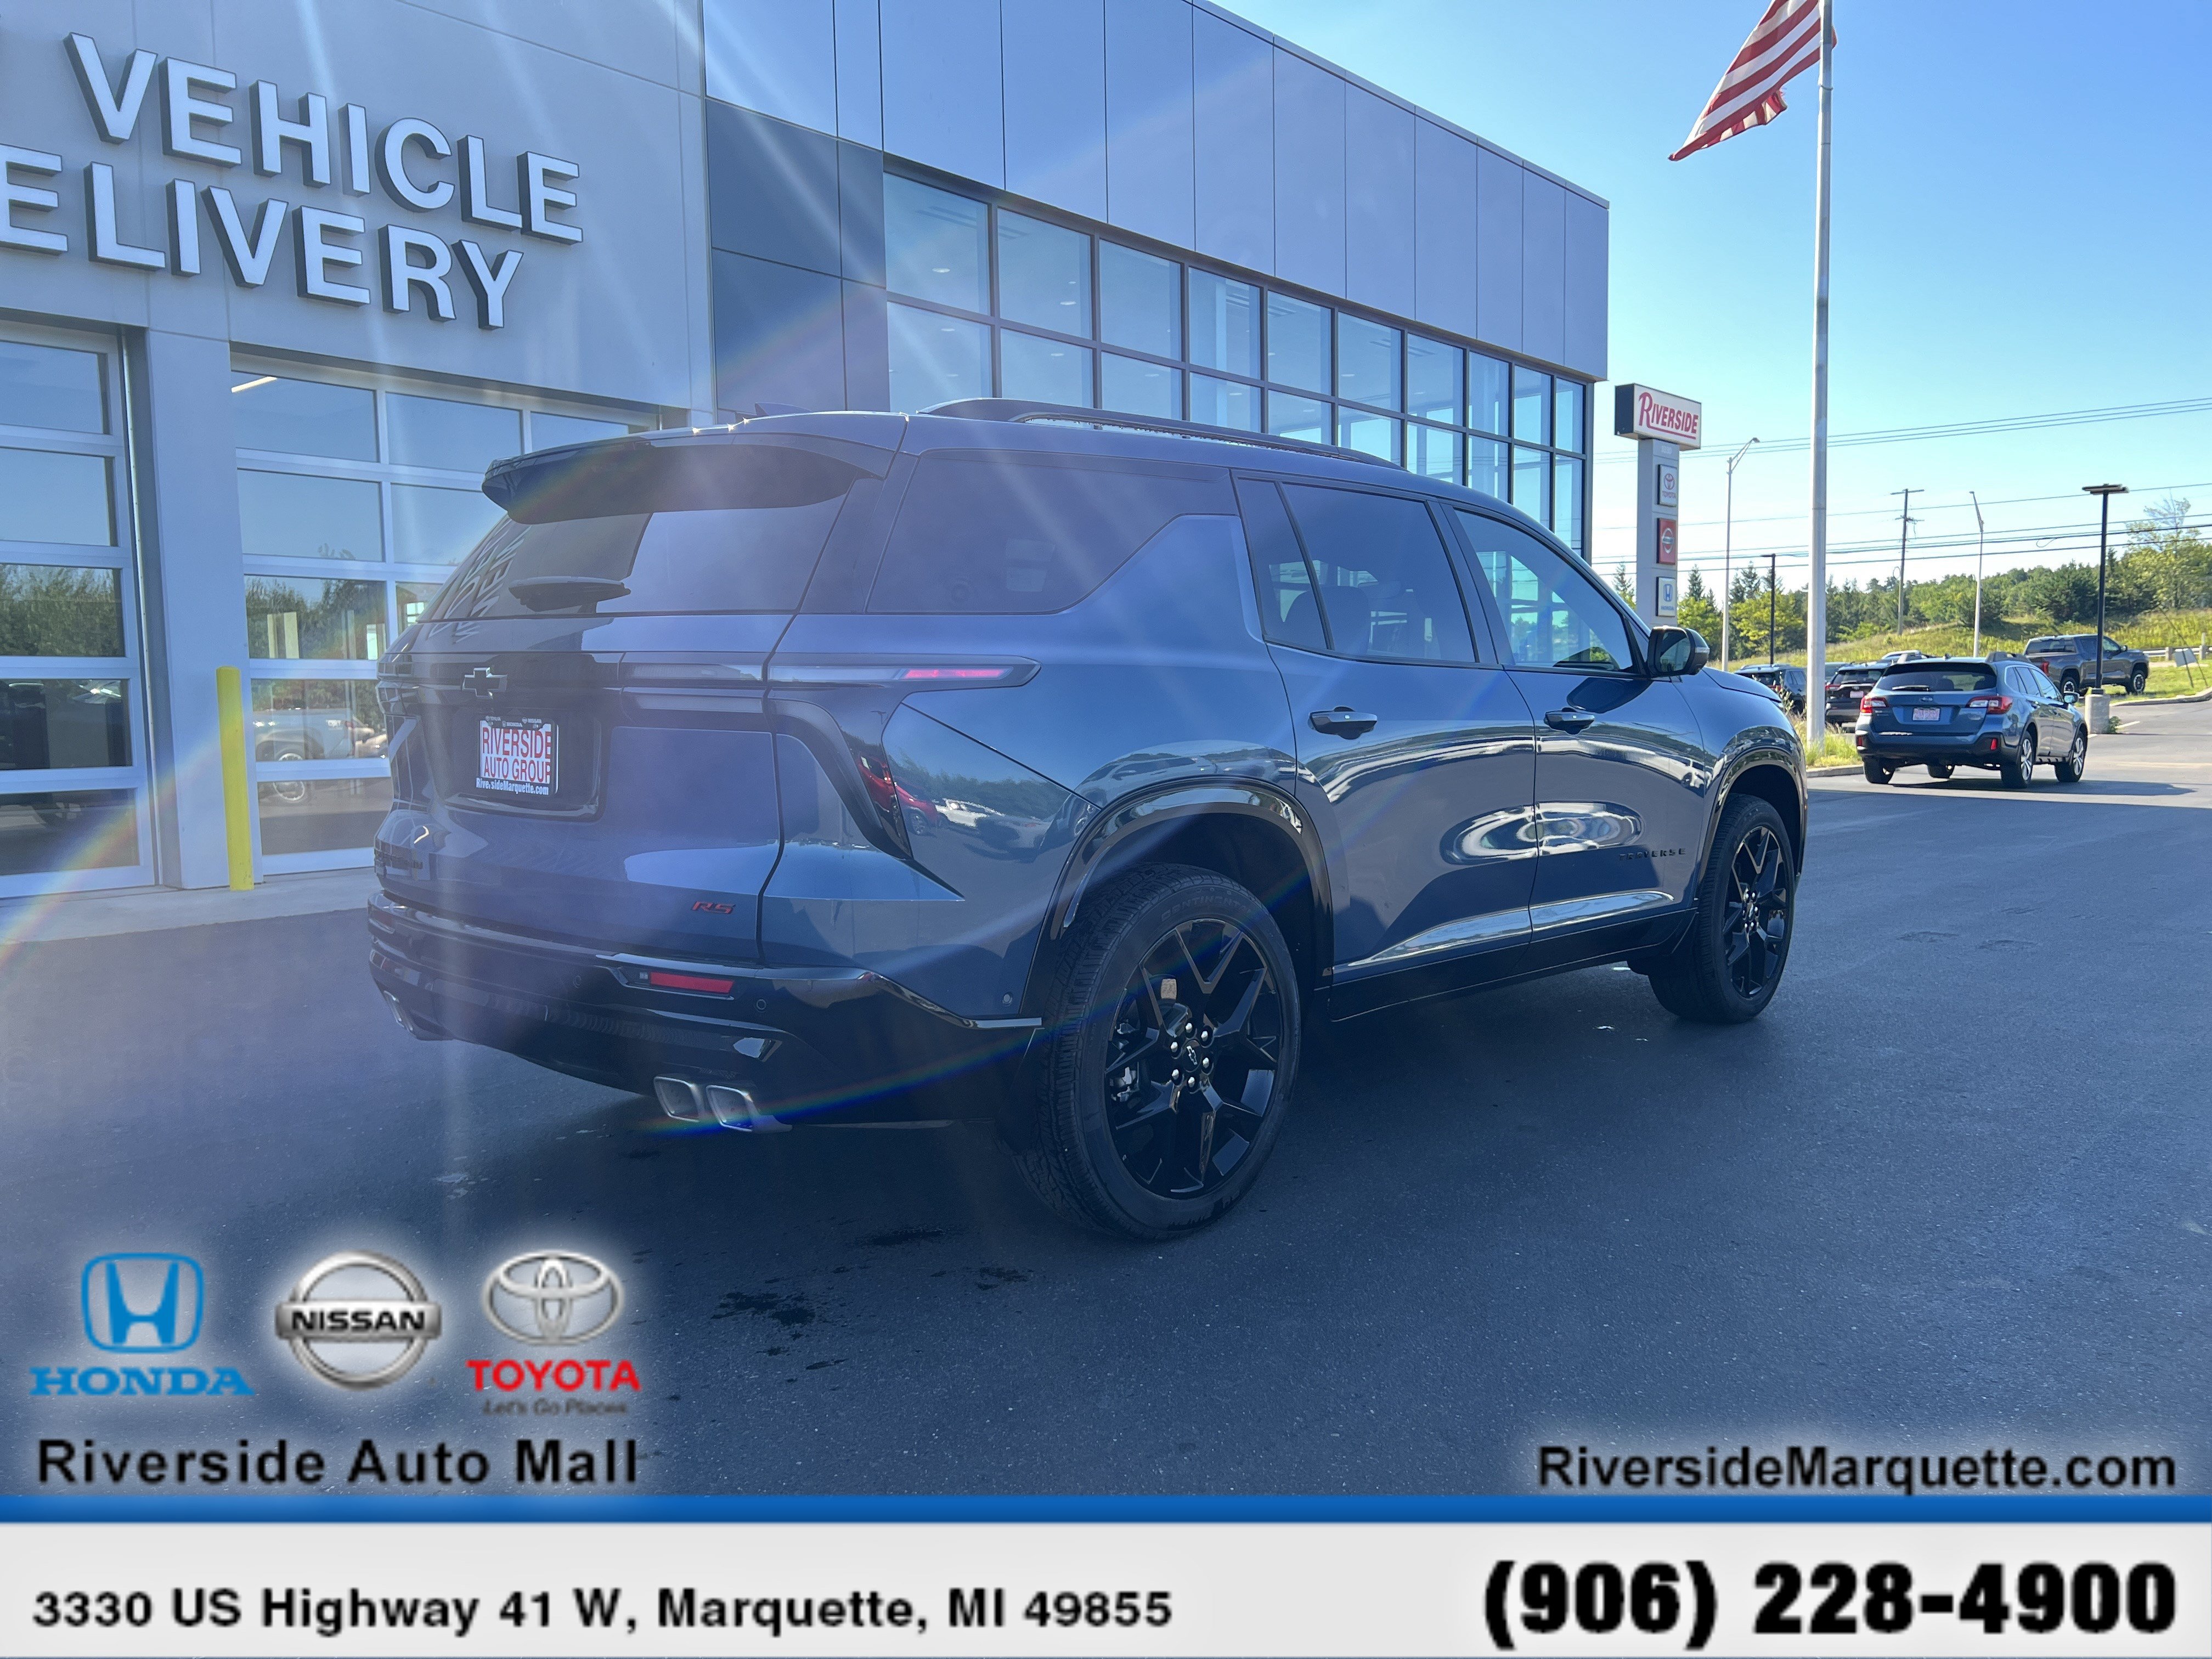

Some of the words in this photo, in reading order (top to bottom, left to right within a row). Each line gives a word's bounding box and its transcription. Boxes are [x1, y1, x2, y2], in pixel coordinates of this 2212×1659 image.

[63, 32, 583, 245] VEHICLE
[1639, 392, 1699, 434] RIVERSIDE
[482, 727, 552, 759] RIVERSIDE
[484, 755, 509, 780] AUTO
[691, 901, 736, 915] RS
